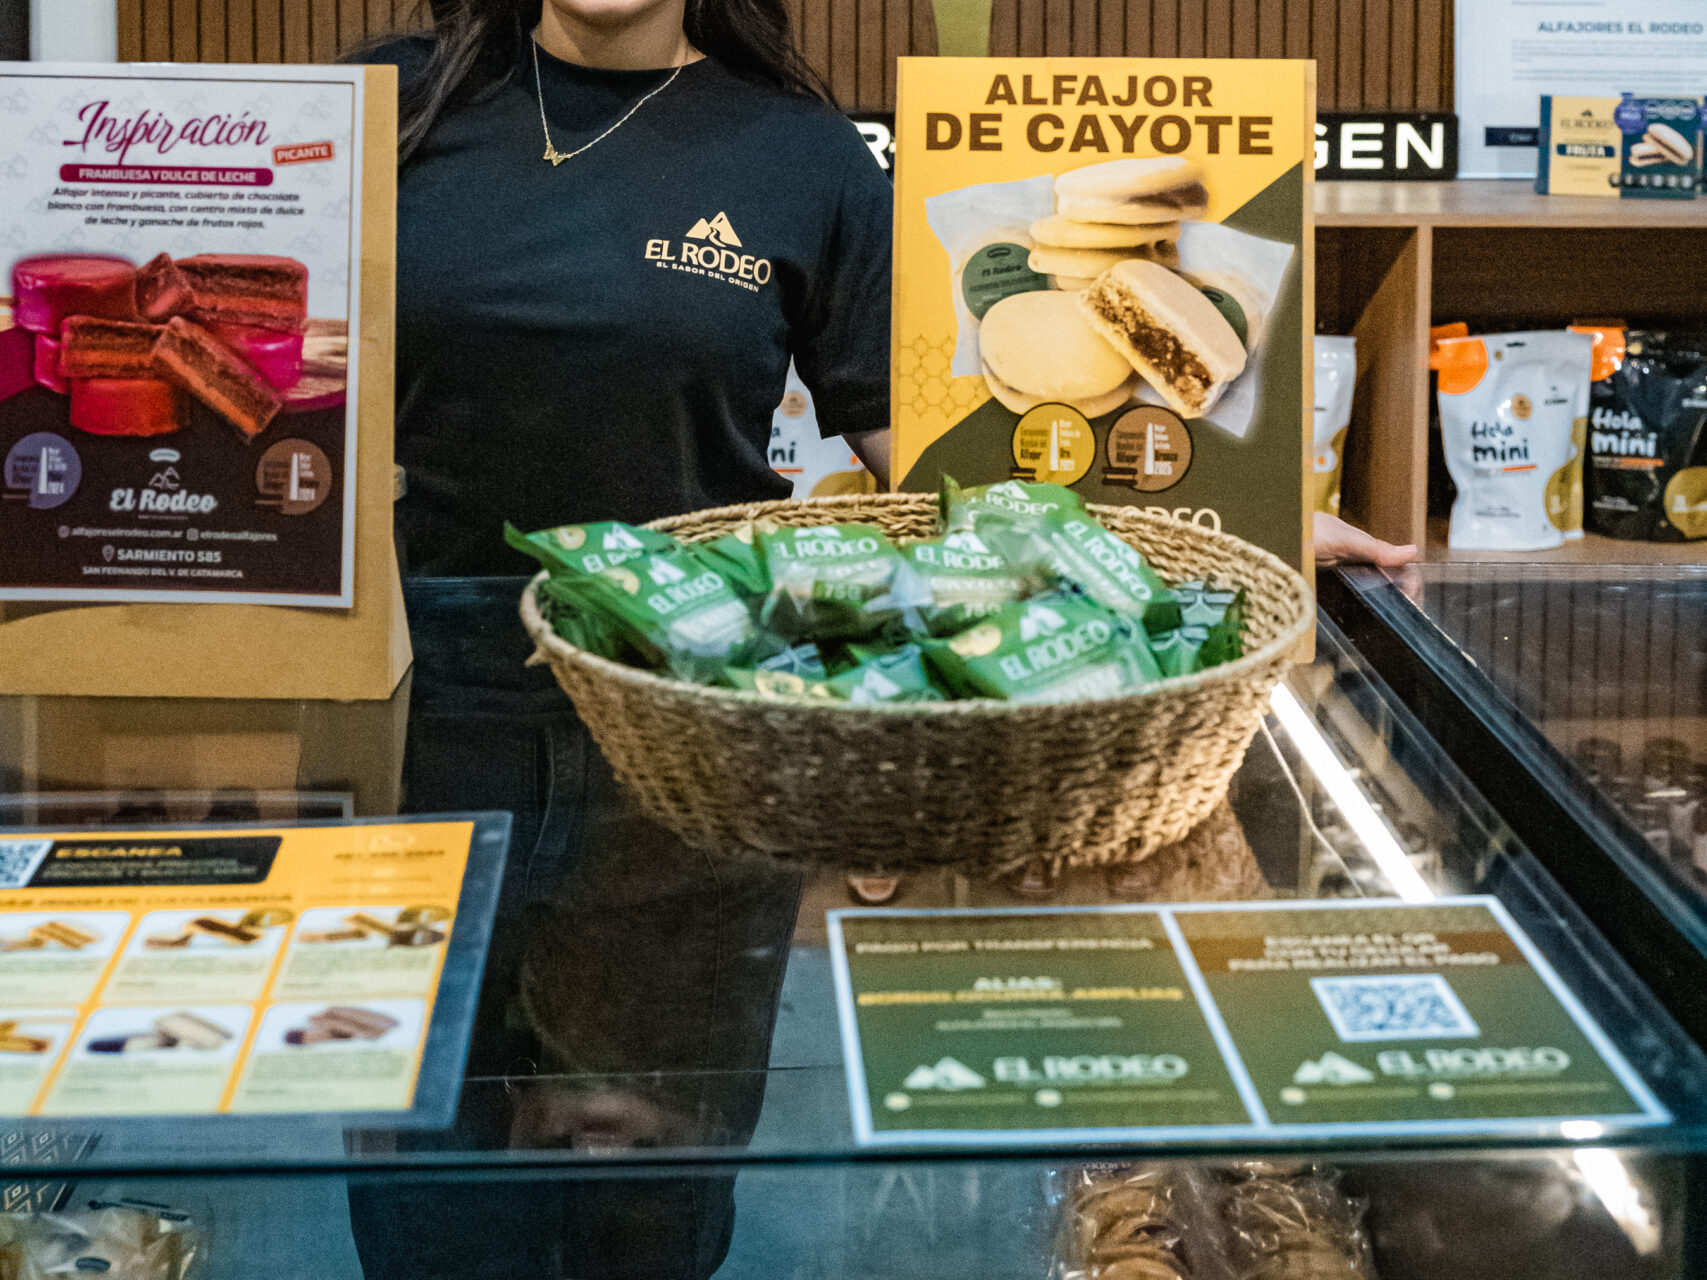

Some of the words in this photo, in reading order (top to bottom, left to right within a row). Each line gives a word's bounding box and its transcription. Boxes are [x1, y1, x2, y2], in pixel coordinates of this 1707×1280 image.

[1538, 21, 1623, 34] ALFAJORES
[1628, 22, 1644, 34] EL
[1649, 22, 1704, 35] RODEO
[984, 73, 1214, 107] ALFAJOR
[63, 100, 269, 166] Inspiración
[925, 111, 1002, 152] DE
[1026, 112, 1273, 156] CAYOTE
[276, 148, 329, 161] PICANTE
[79, 168, 150, 181] FRAMBUESA
[160, 170, 199, 182] DULCE
[201, 171, 216, 182] DE
[218, 171, 257, 183] LECHE
[644, 239, 676, 260] EL
[681, 242, 771, 285] RODEO
[671, 263, 705, 276] SABOR
[708, 271, 726, 281] DEL
[728, 276, 759, 293] ORIGEN
[1471, 421, 1514, 439] Hola
[1591, 406, 1643, 430] Hola
[1473, 438, 1529, 463] mini
[1591, 431, 1658, 458] mini
[108, 487, 137, 512] El
[138, 488, 218, 514] Rodeo
[117, 548, 195, 563] SARMIENTO
[196, 550, 222, 563] 585
[794, 536, 879, 559] RODEO
[82, 566, 100, 576] SAN
[101, 567, 150, 577] FERNANDO
[151, 568, 168, 577] DEL
[1083, 536, 1152, 601] RODEO
[999, 654, 1032, 681] EL
[1025, 619, 1111, 671] RODEO
[993, 1055, 1041, 1082] EL
[1042, 1053, 1190, 1080] RODEO
[1376, 1049, 1424, 1076] EL
[1424, 1045, 1572, 1073] RODEO
